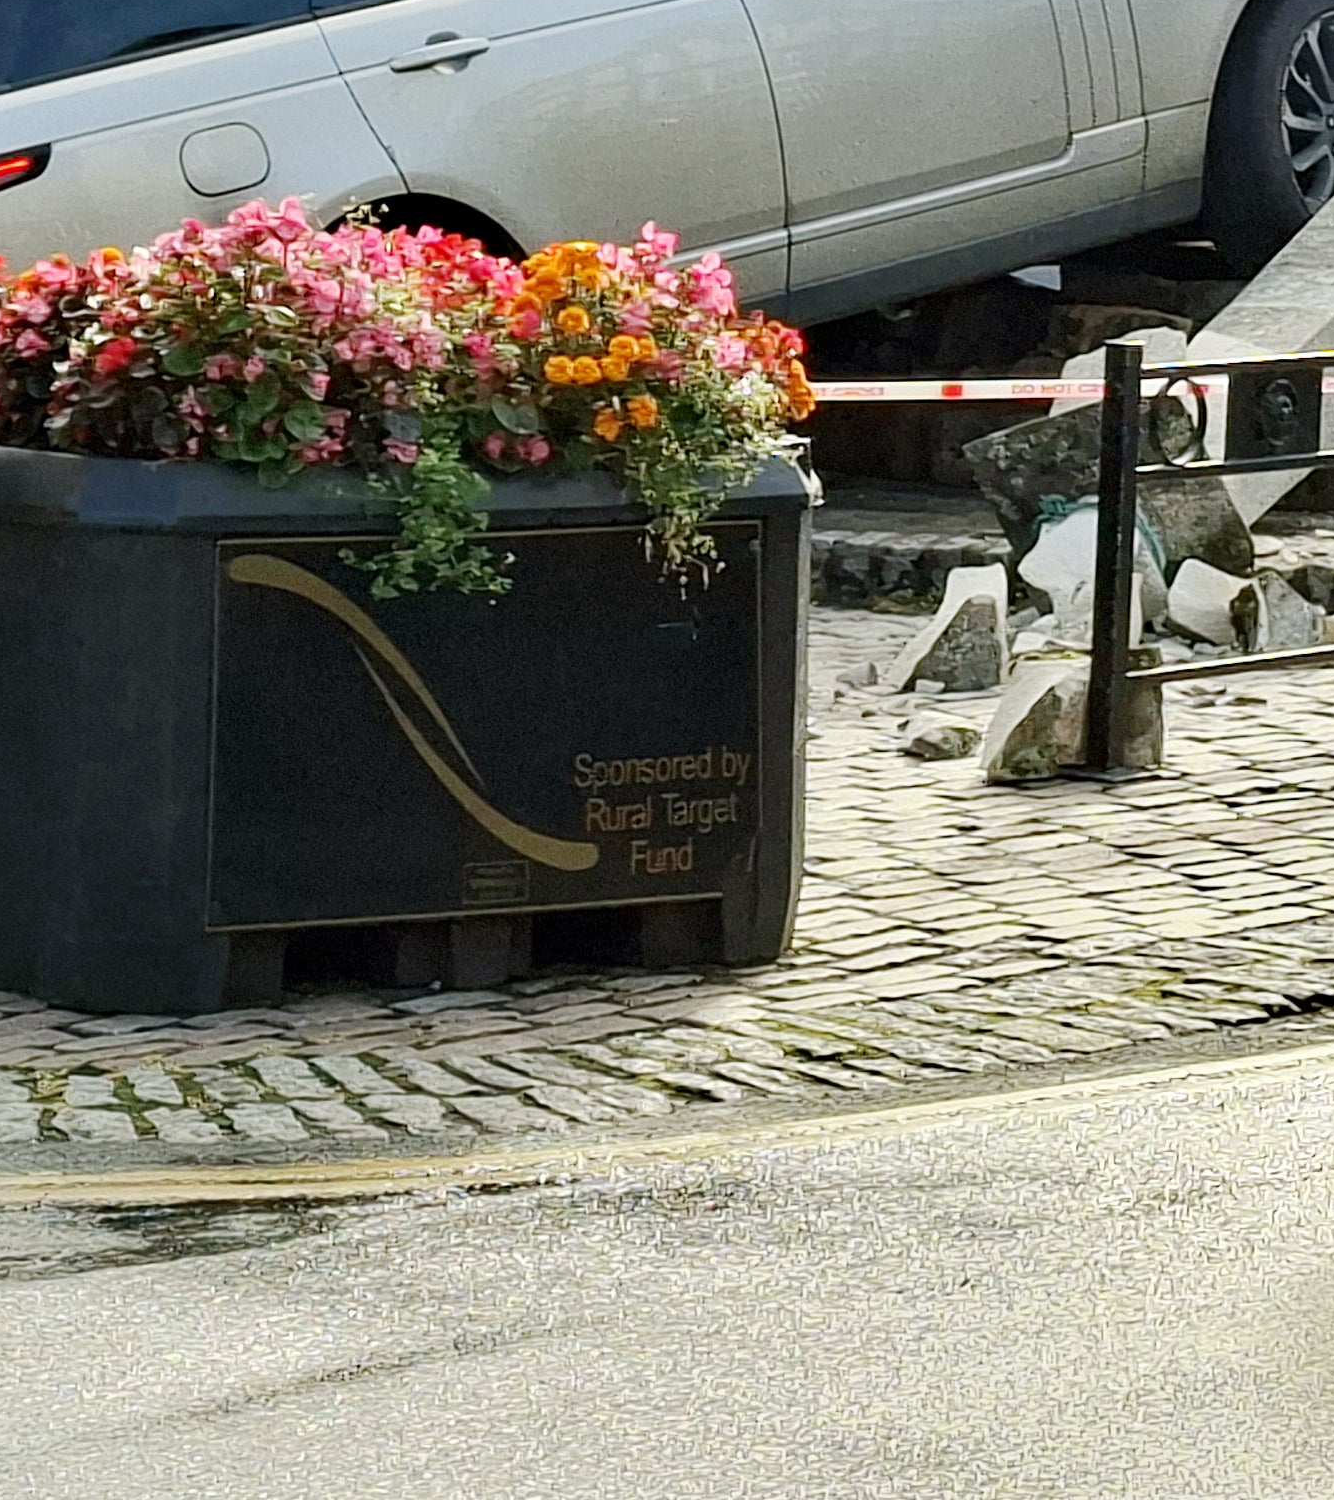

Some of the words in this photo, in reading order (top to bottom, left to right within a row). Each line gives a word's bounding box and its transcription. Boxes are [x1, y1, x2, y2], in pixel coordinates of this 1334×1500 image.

[574, 746, 713, 795] Sponsored
[722, 744, 751, 786] by
[586, 795, 652, 832] Rural
[660, 792, 738, 834] Target
[629, 836, 694, 875] Fund
